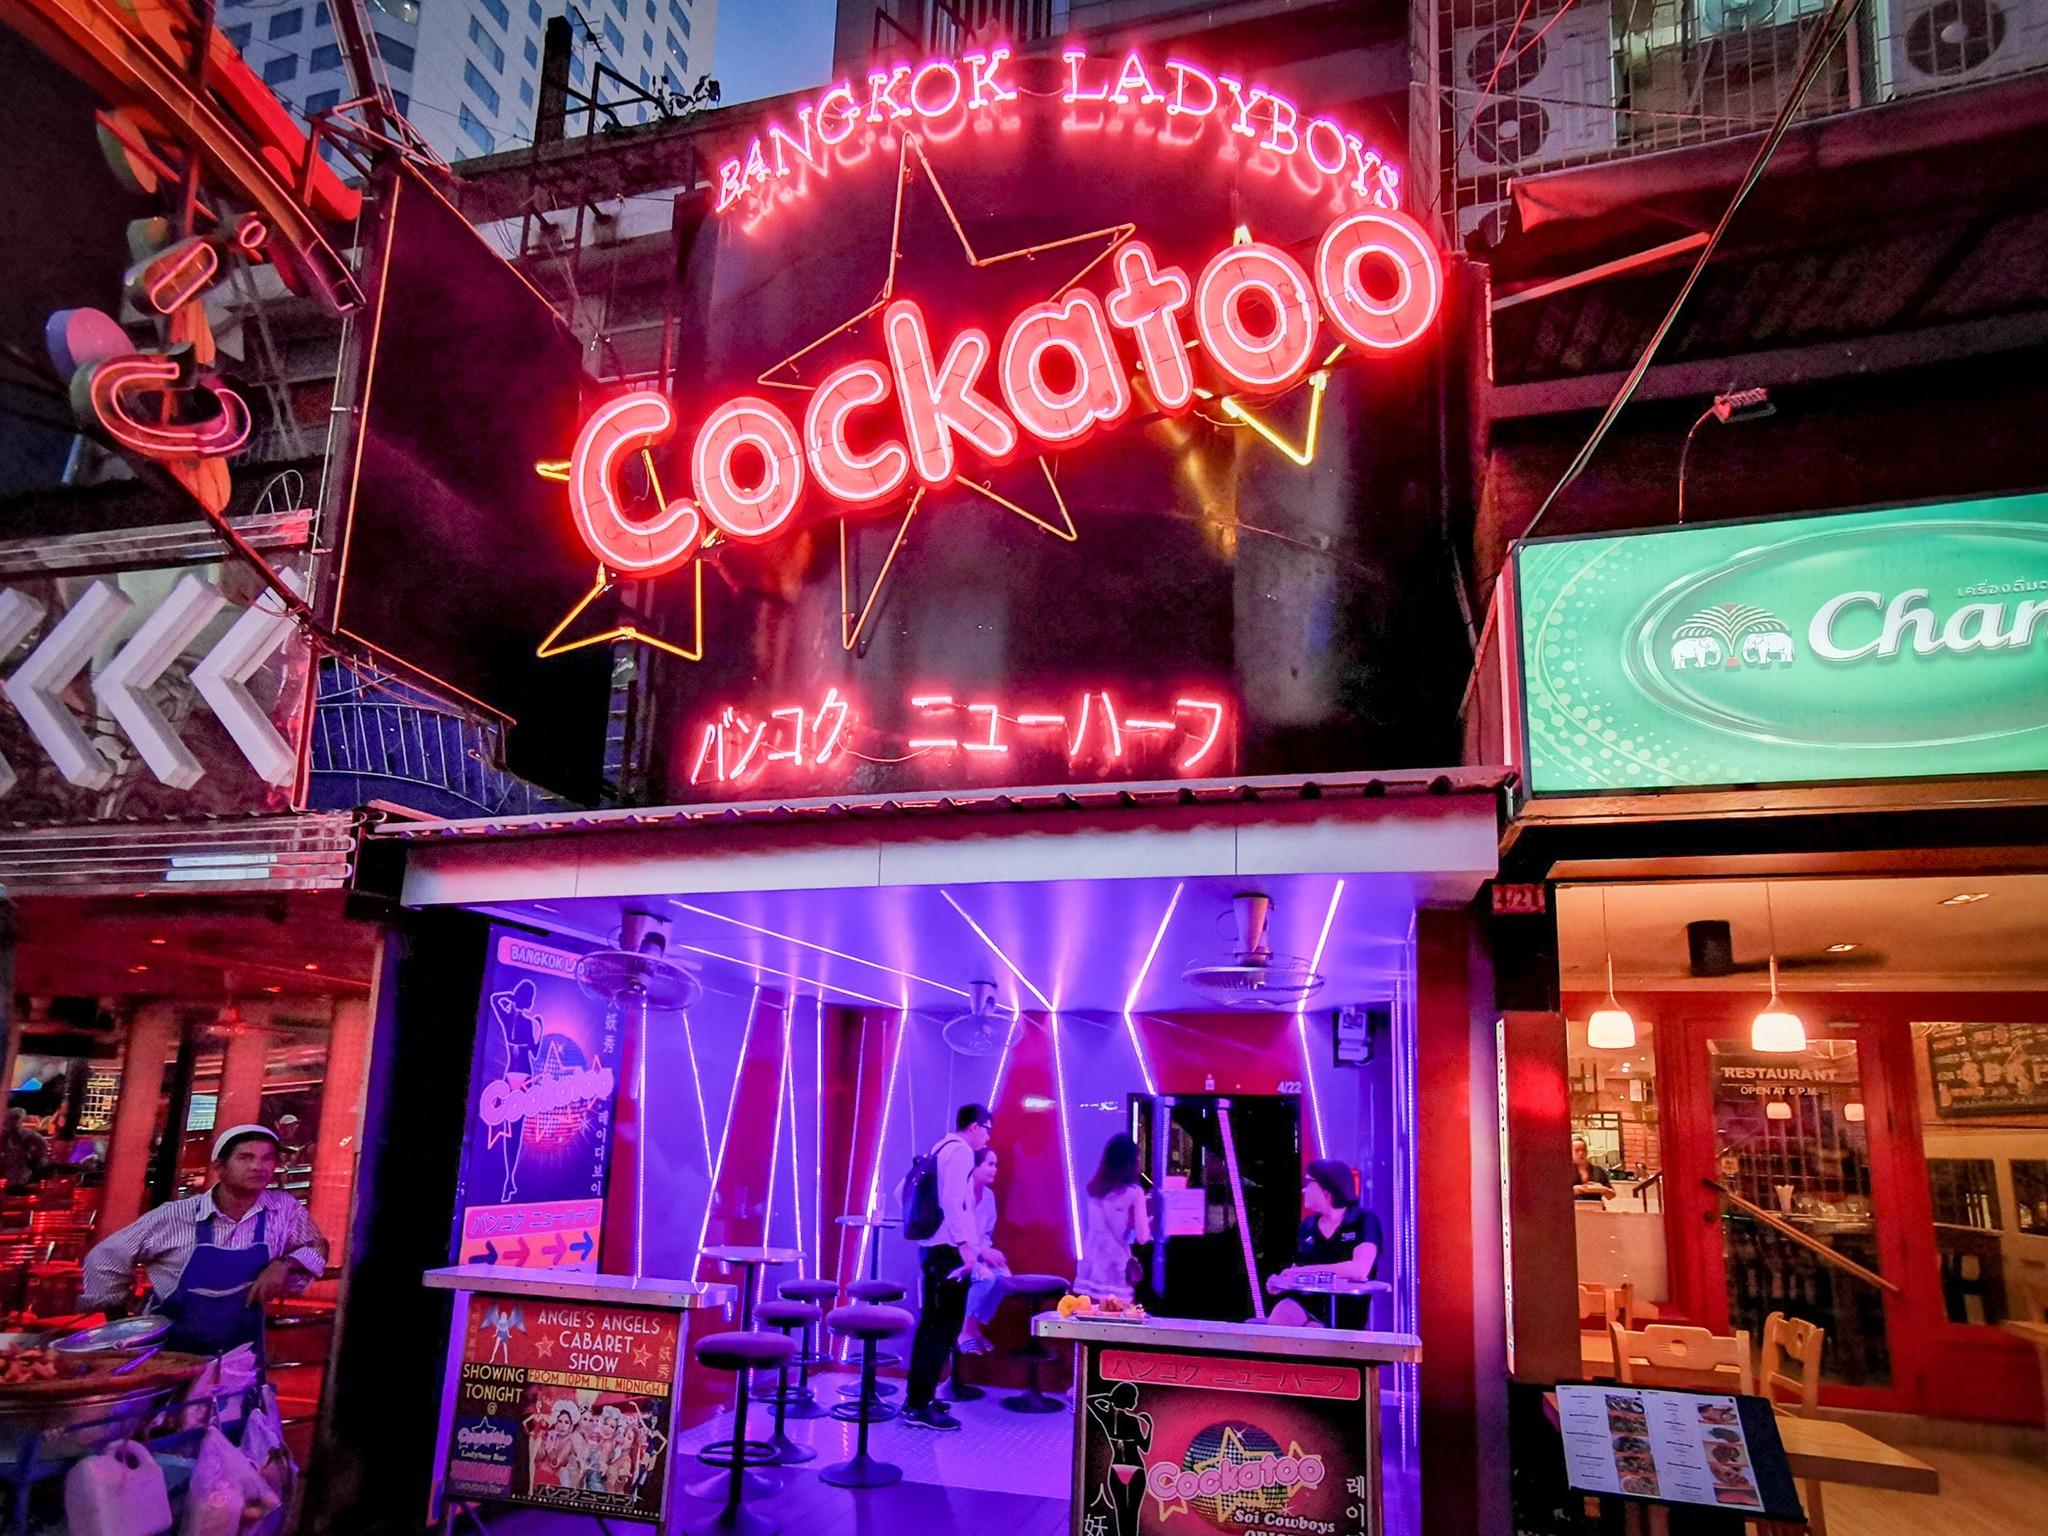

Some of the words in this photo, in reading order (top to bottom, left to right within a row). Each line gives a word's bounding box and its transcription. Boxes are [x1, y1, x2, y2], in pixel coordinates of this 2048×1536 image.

[715, 47, 1018, 213] BANGKOK
[1060, 50, 1401, 211] LADYBOYS
[568, 208, 1444, 576] Cockatoo
[690, 688, 849, 785] バンコク
[908, 692, 1224, 768] ニューハーフ
[510, 944, 563, 969] BANGKOK
[1721, 1066, 1837, 1081] RESTAURANT
[1277, 1081, 1302, 1094] 4/22
[1740, 1086, 1771, 1095] OPEN
[1773, 1087, 1786, 1095] AT
[537, 1308, 596, 1330] ANGIE'S
[601, 1313, 661, 1335] ANGELS
[559, 1330, 635, 1354] CABARET
[462, 1363, 525, 1384] SHOWING
[568, 1352, 619, 1374] SHOW
[465, 1382, 524, 1404] TONIGHT
[528, 1370, 559, 1384] FROM
[564, 1374, 590, 1388] 10PM
[594, 1376, 609, 1389] TIL
[614, 1378, 669, 1396] MIDNIGHT
[1148, 1454, 1326, 1501] Cockatoo
[1234, 1509, 1260, 1524] Soi
[1263, 1512, 1336, 1534] Cowboys
